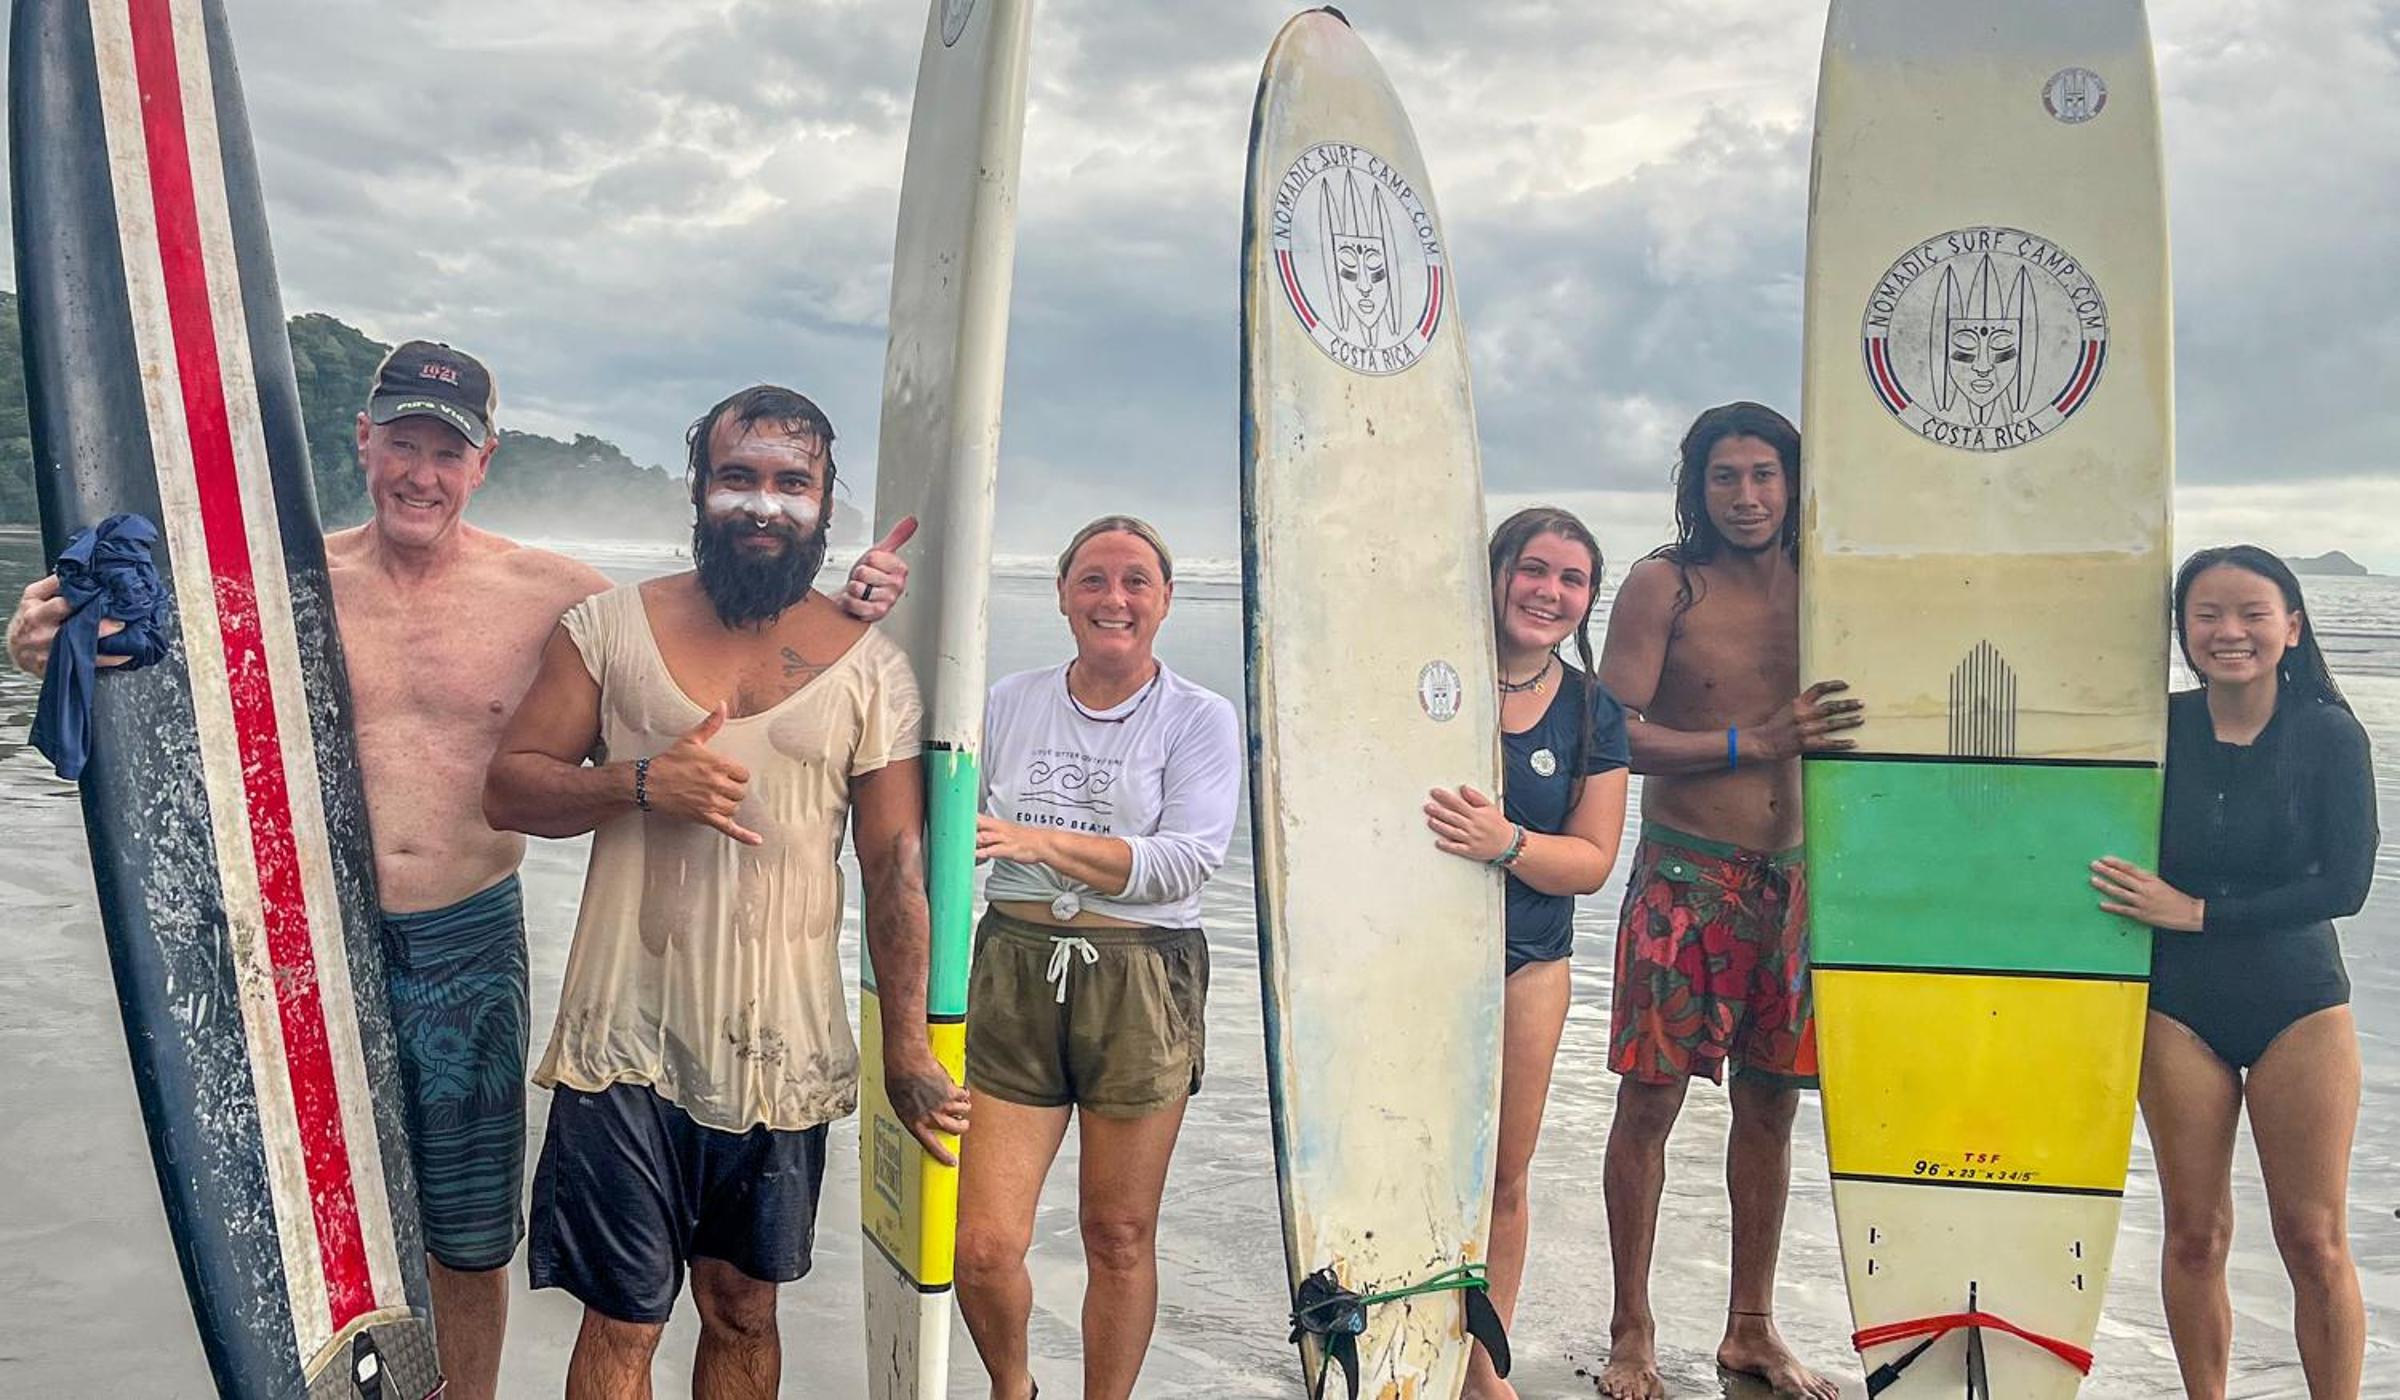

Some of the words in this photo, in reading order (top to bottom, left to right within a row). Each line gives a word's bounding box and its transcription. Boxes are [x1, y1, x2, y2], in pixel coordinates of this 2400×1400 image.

[1275, 156, 1317, 240] NOMADIC
[1318, 145, 1358, 168] SURF
[1868, 244, 1939, 328] NOMADIC
[1947, 231, 2005, 252] SURF
[1330, 338, 1378, 371] COSTA
[1383, 342, 1415, 369] RICA
[1922, 417, 1985, 450] COSTA
[1995, 418, 2043, 446] RICA
[1016, 812, 1064, 826] EDISTO
[1964, 1152, 2001, 1164] TSF
